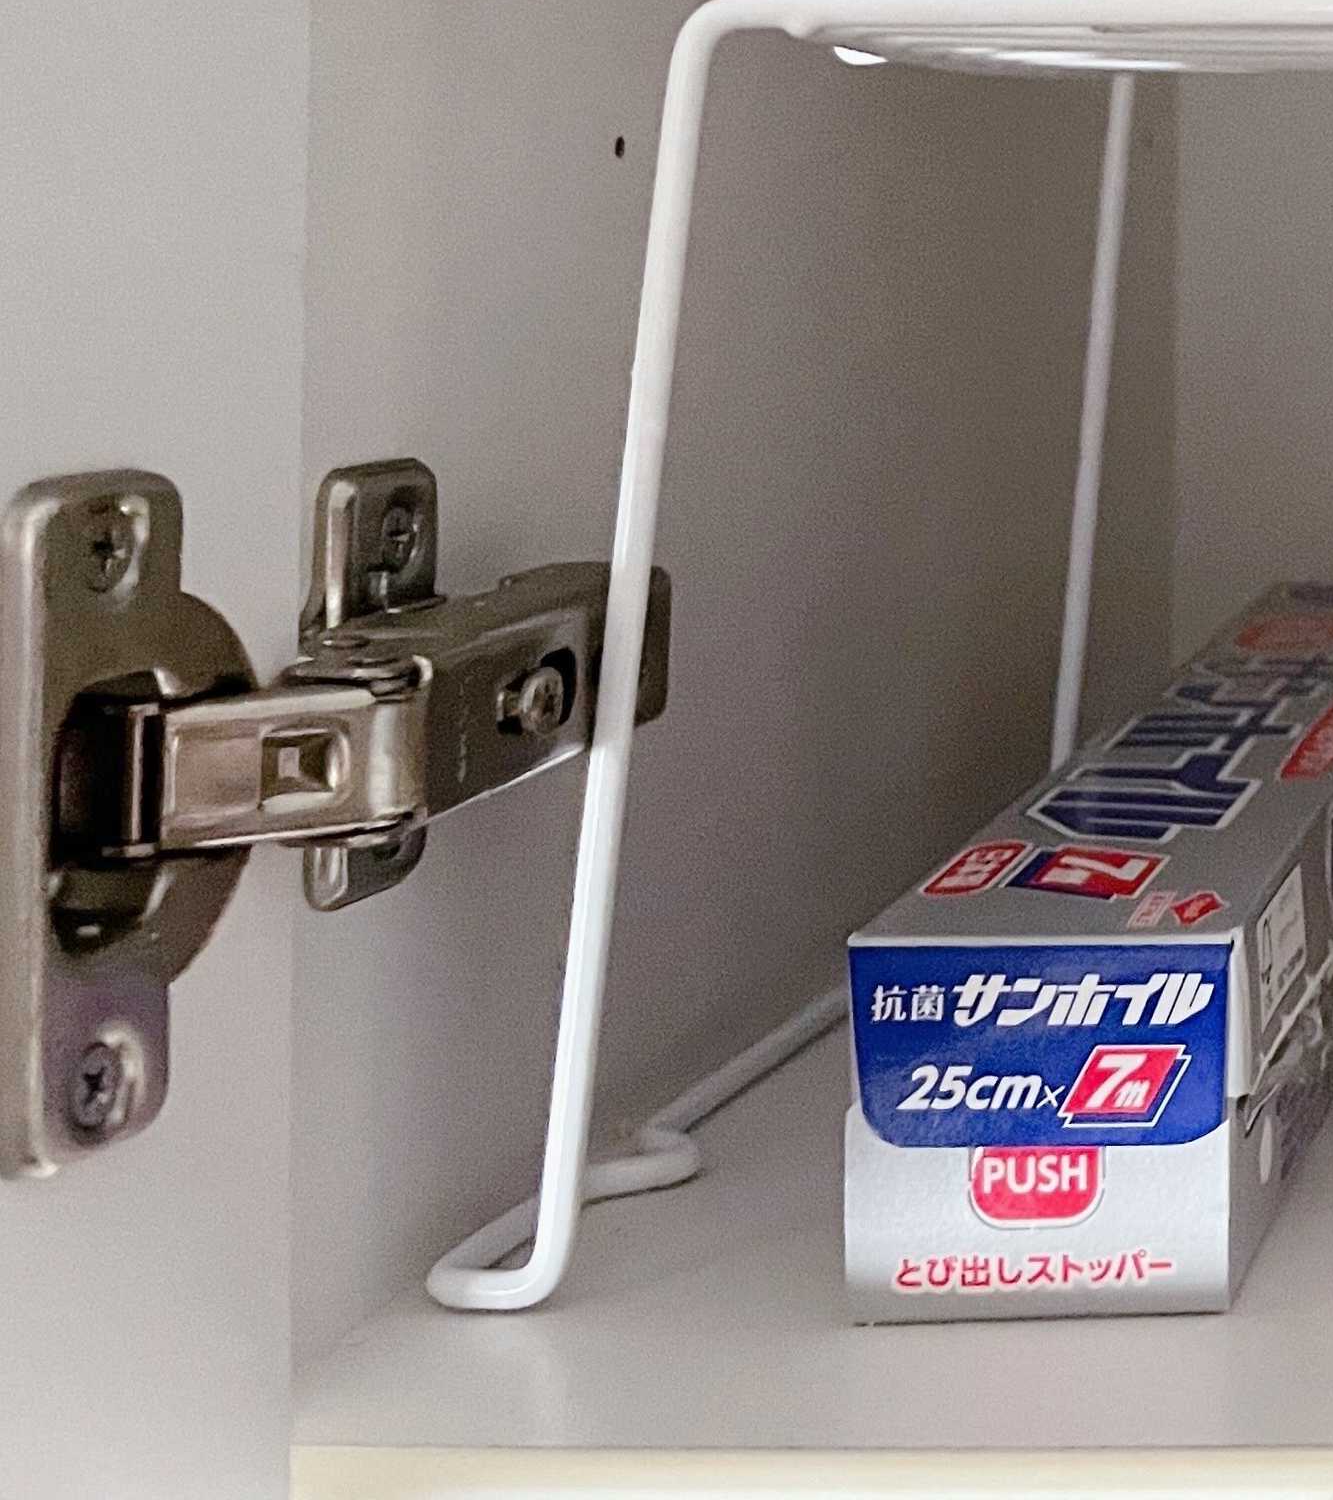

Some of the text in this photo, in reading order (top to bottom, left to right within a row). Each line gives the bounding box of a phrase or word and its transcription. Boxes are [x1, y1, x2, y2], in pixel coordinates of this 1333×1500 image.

[982, 1156, 1088, 1195] PUSH
[896, 1250, 1172, 1288] とび出しストッパー
